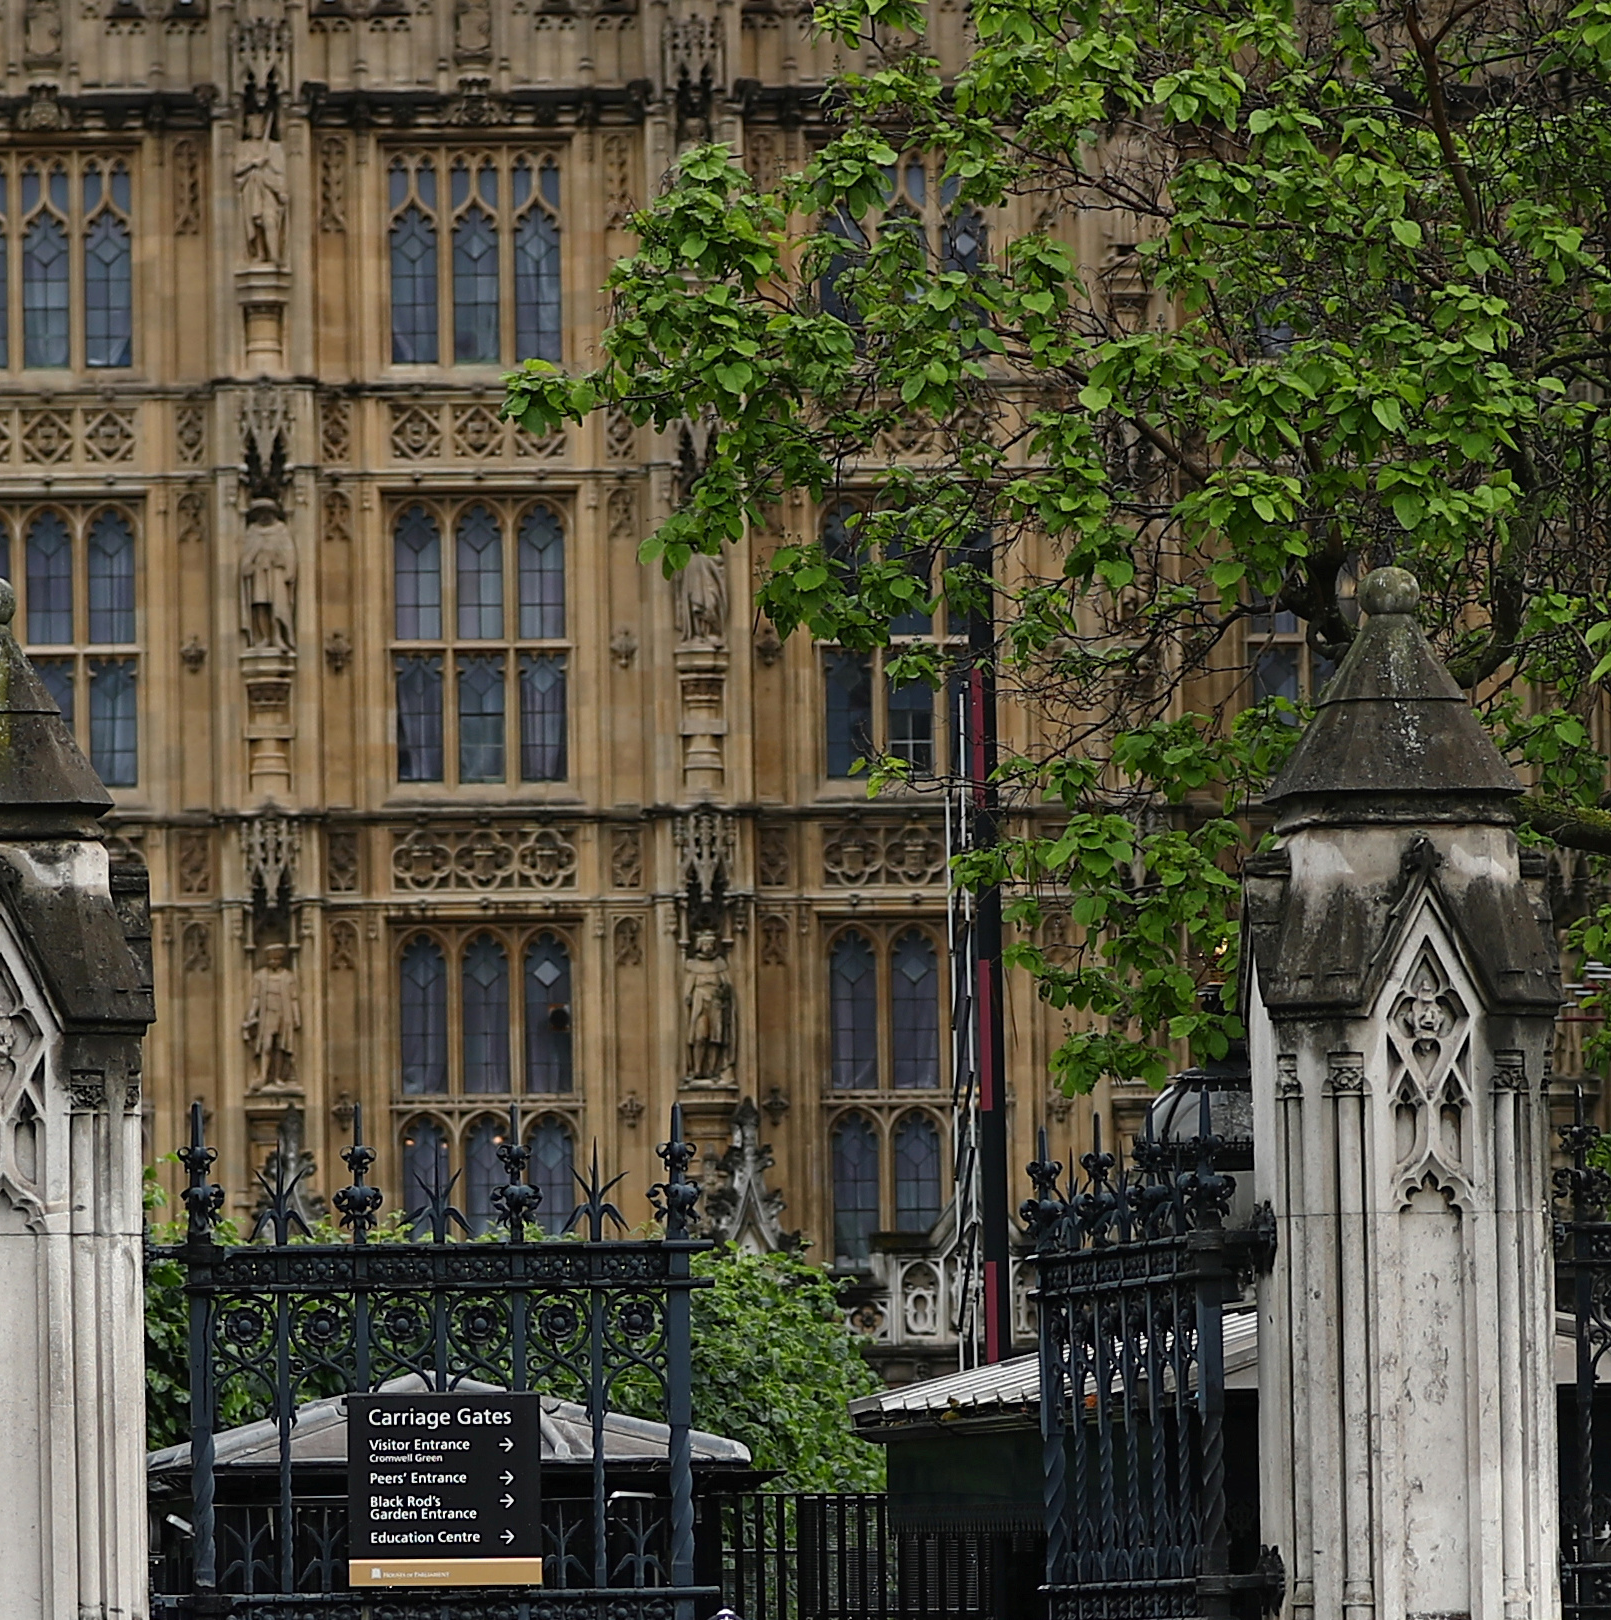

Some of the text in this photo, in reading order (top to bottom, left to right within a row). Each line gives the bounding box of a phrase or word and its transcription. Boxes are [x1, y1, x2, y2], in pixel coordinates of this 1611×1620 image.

[368, 1407, 512, 1430] Carriage Gates
[368, 1439, 470, 1451] Visitor Entrance
[369, 1454, 443, 1463] Cromwell Green
[411, 1472, 467, 1484] Entrance
[370, 1496, 404, 1508] Black
[370, 1508, 477, 1520] Garden Entrance
[370, 1531, 481, 1544] Education Centre
